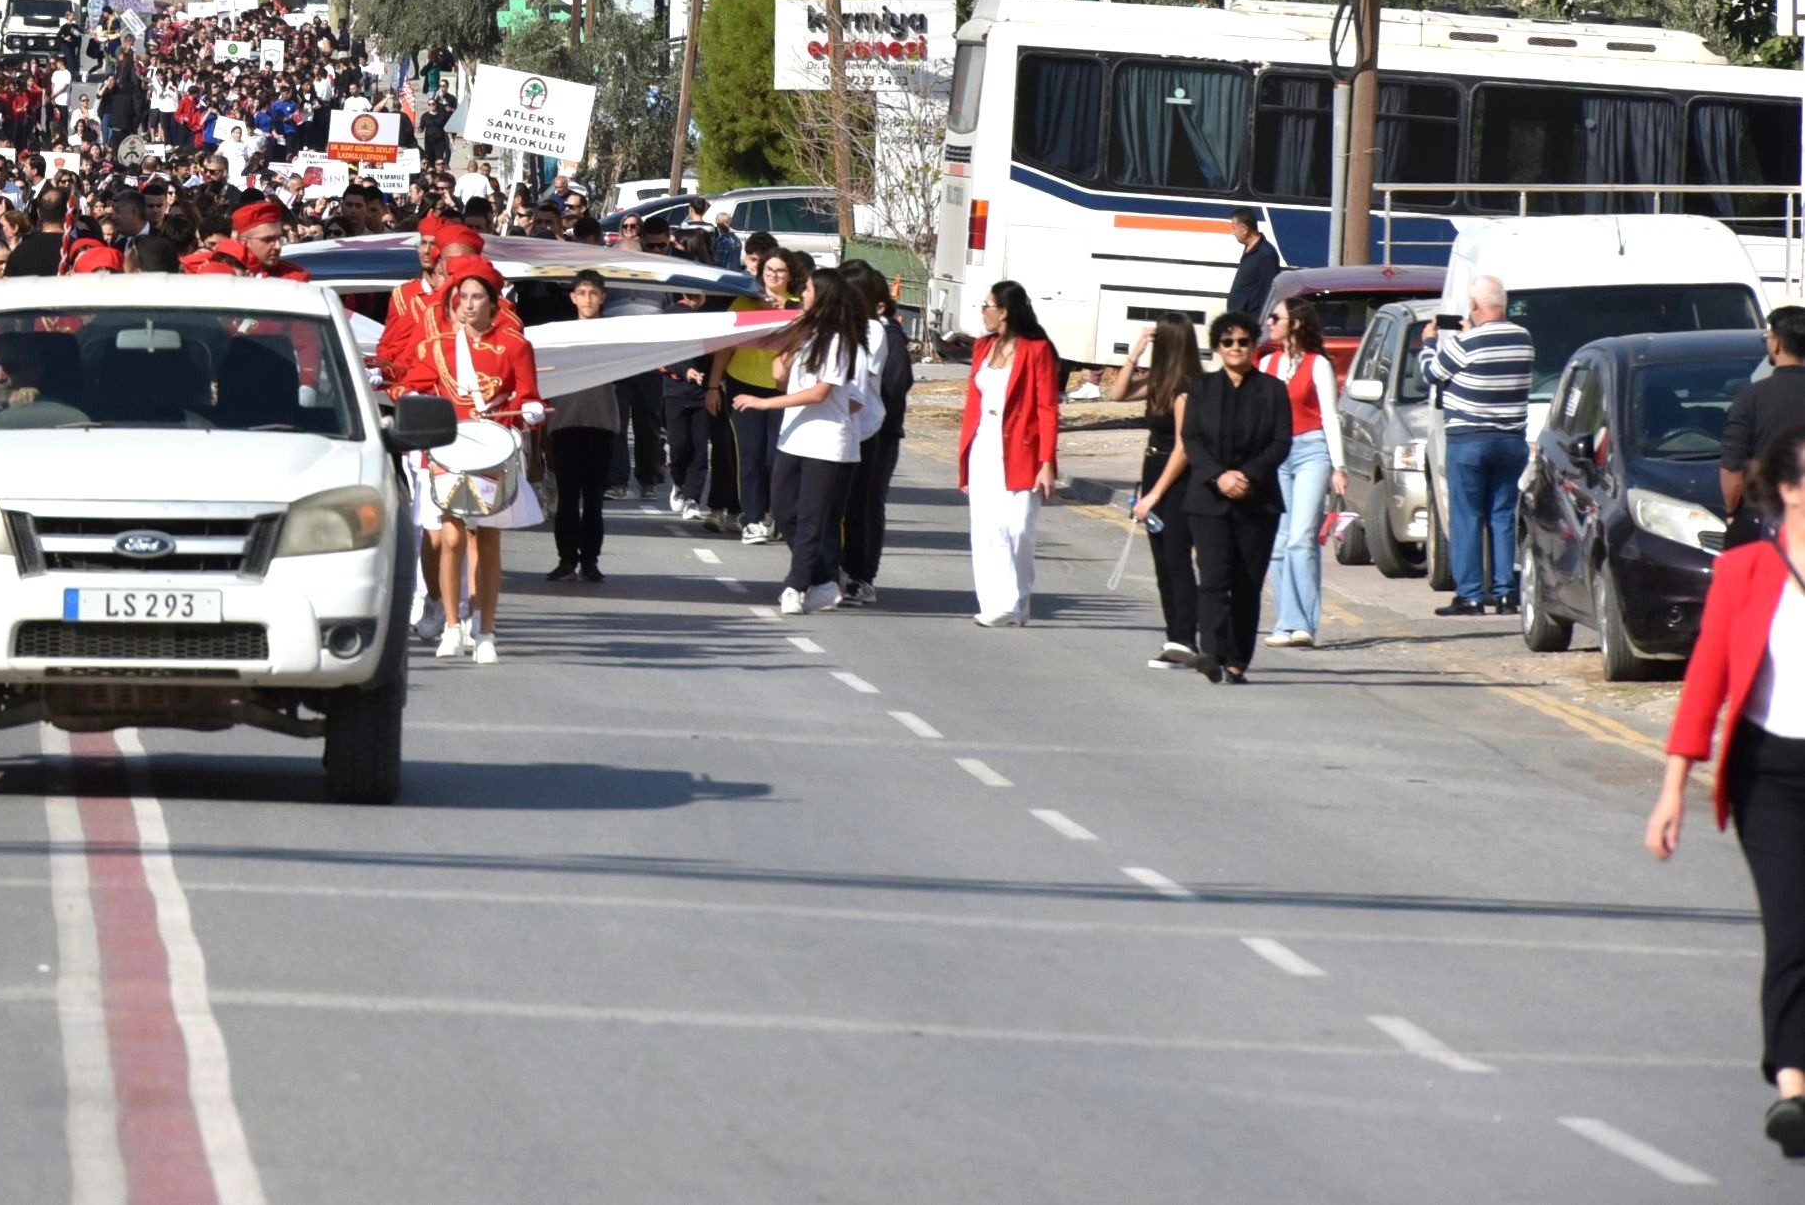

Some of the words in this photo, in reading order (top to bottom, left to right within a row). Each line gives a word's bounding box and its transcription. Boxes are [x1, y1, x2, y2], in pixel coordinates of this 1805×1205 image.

[807, 4, 928, 41] krmiya
[486, 117, 566, 141] SANVERLER
[503, 108, 555, 126] ATLEKS
[375, 146, 396, 154] DEVLET
[483, 130, 565, 154] ORTAOKULU
